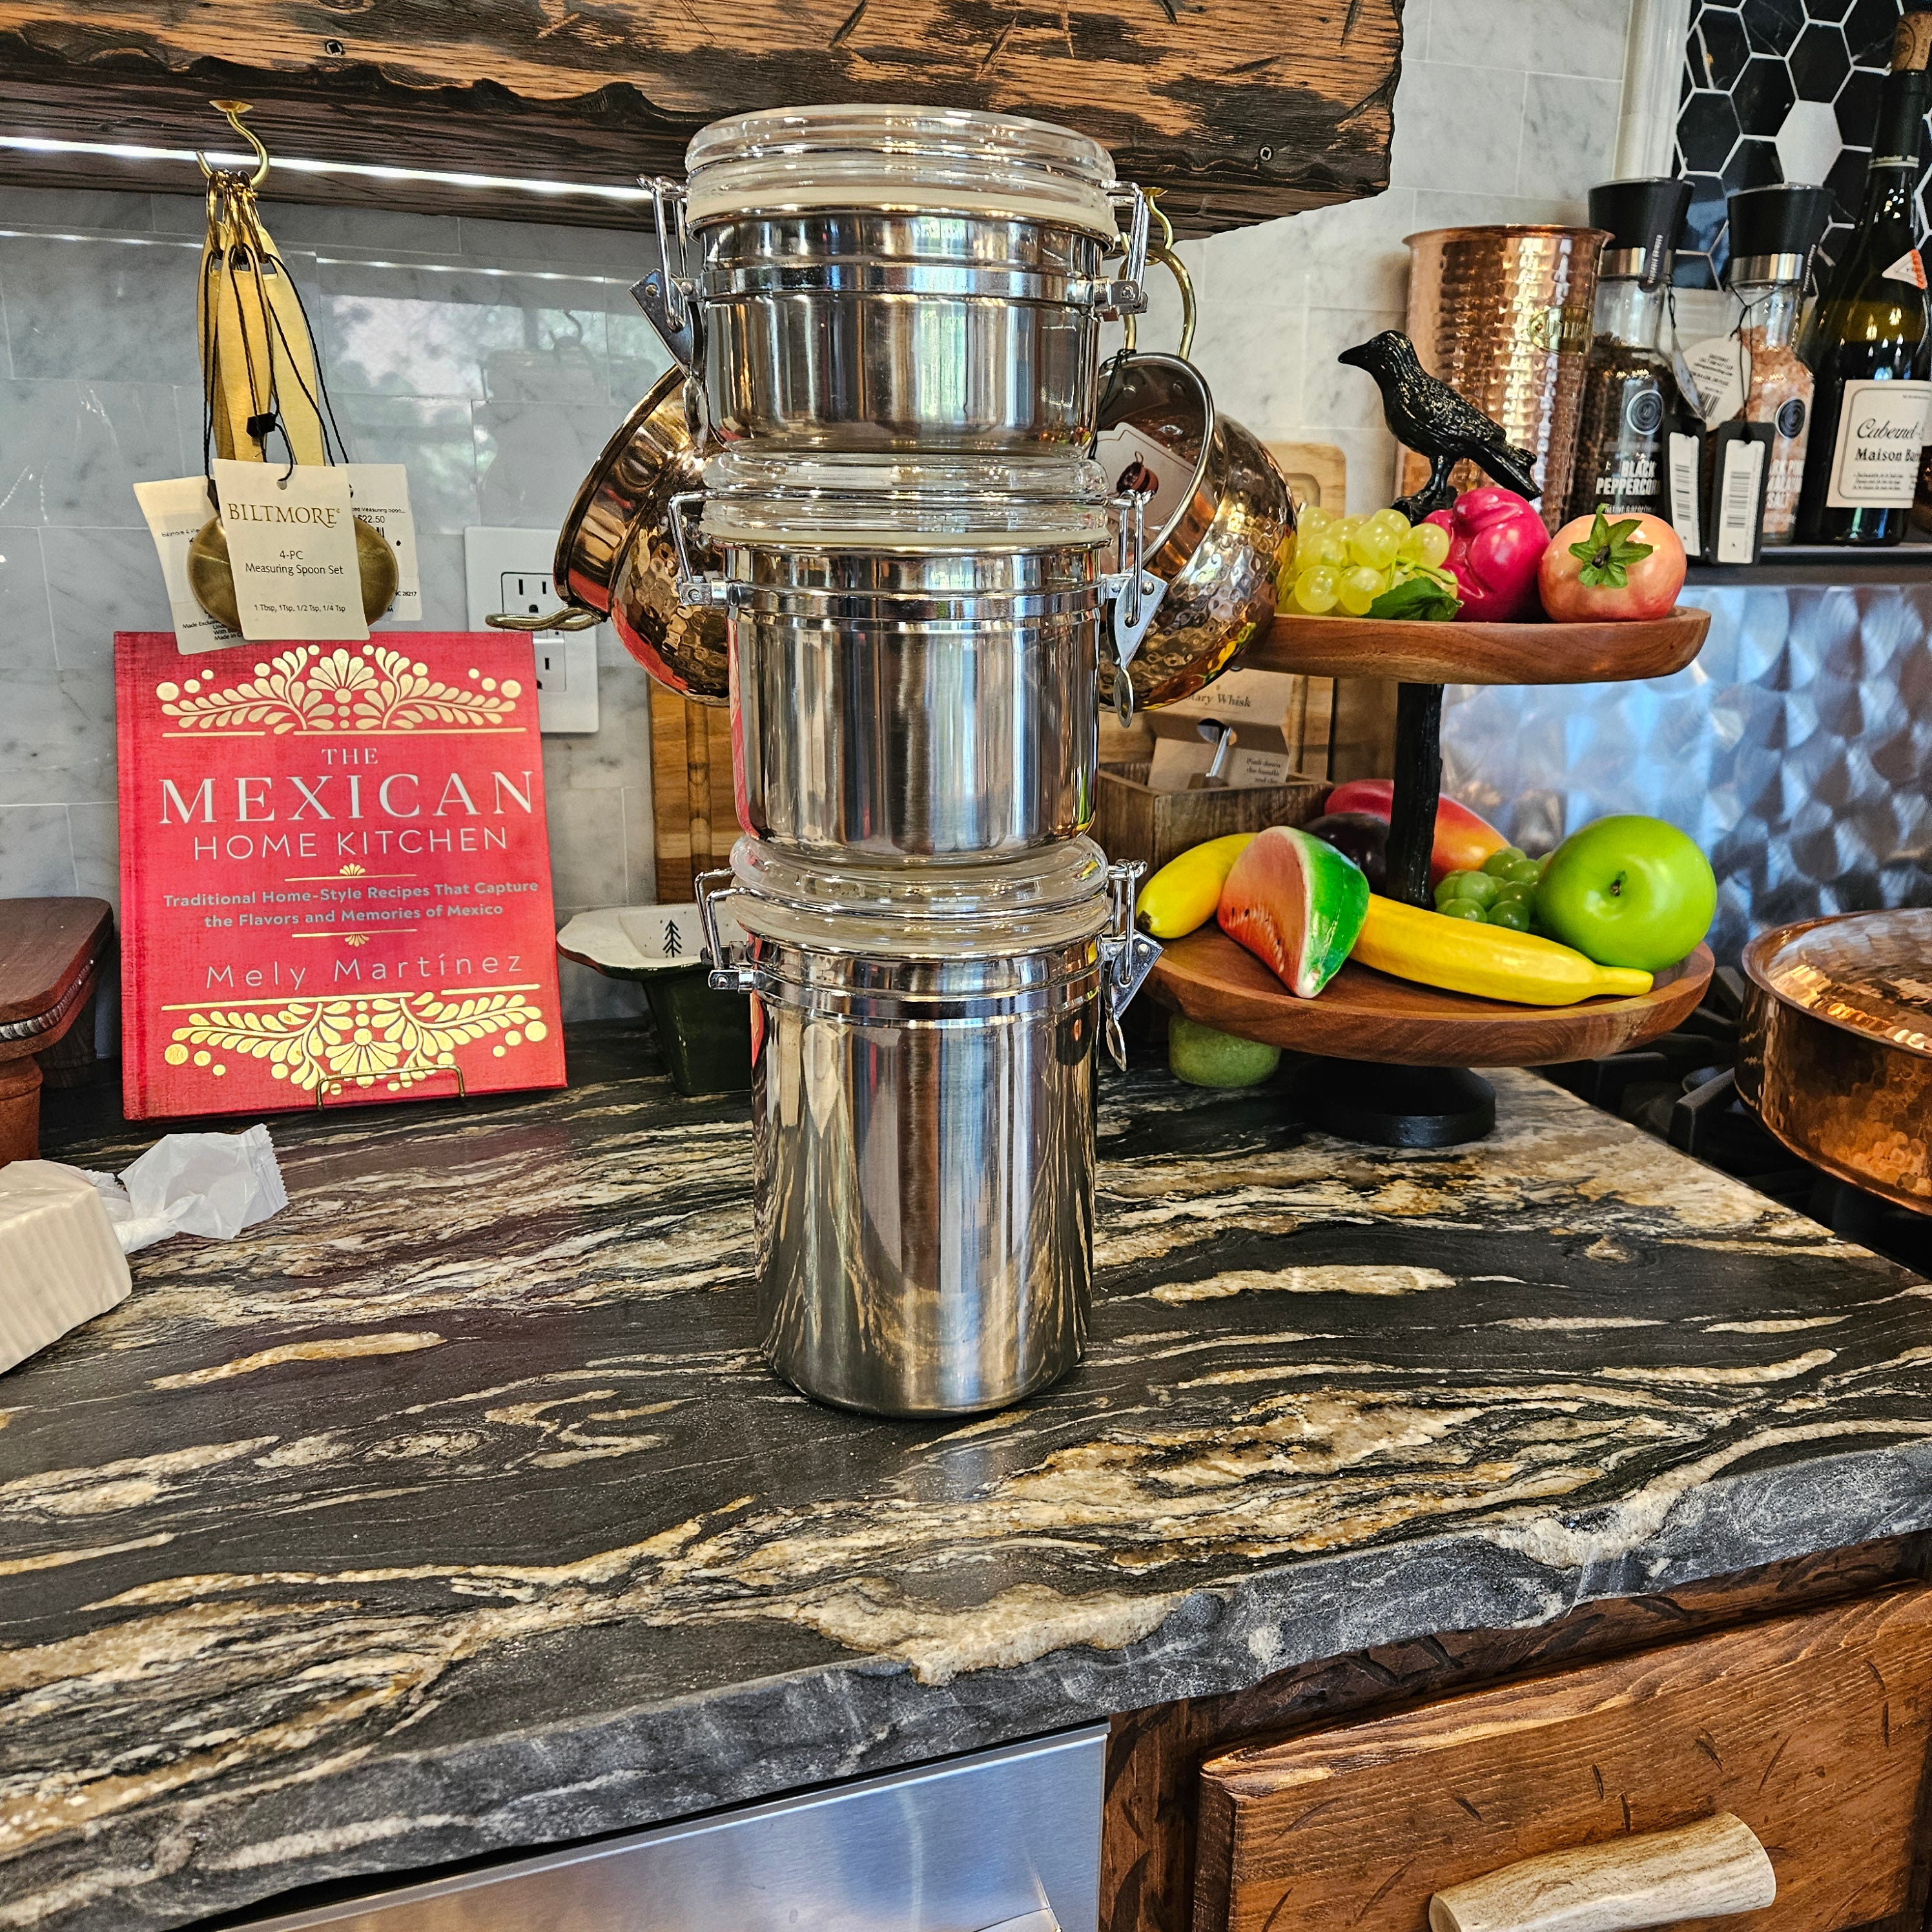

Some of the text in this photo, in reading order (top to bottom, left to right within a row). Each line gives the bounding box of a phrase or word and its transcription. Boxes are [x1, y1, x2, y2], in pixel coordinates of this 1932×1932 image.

[1855, 447, 1902, 462] Maison
[1621, 460, 1658, 478] BLACK
[228, 503, 337, 528] BILTMORE
[279, 550, 303, 560] 4-PC
[245, 563, 344, 577] Measuring Spoon Set
[1218, 694, 1251, 708] Whisk
[321, 748, 378, 765] THE
[159, 770, 534, 824] MEXICAN
[194, 827, 506, 860] HOME KITCHEN
[163, 881, 539, 907] Traditional Home-Style Recipes That Capture
[204, 903, 503, 927] the Flavors and Memories of Mexico
[206, 953, 522, 991] Mely Martínez
